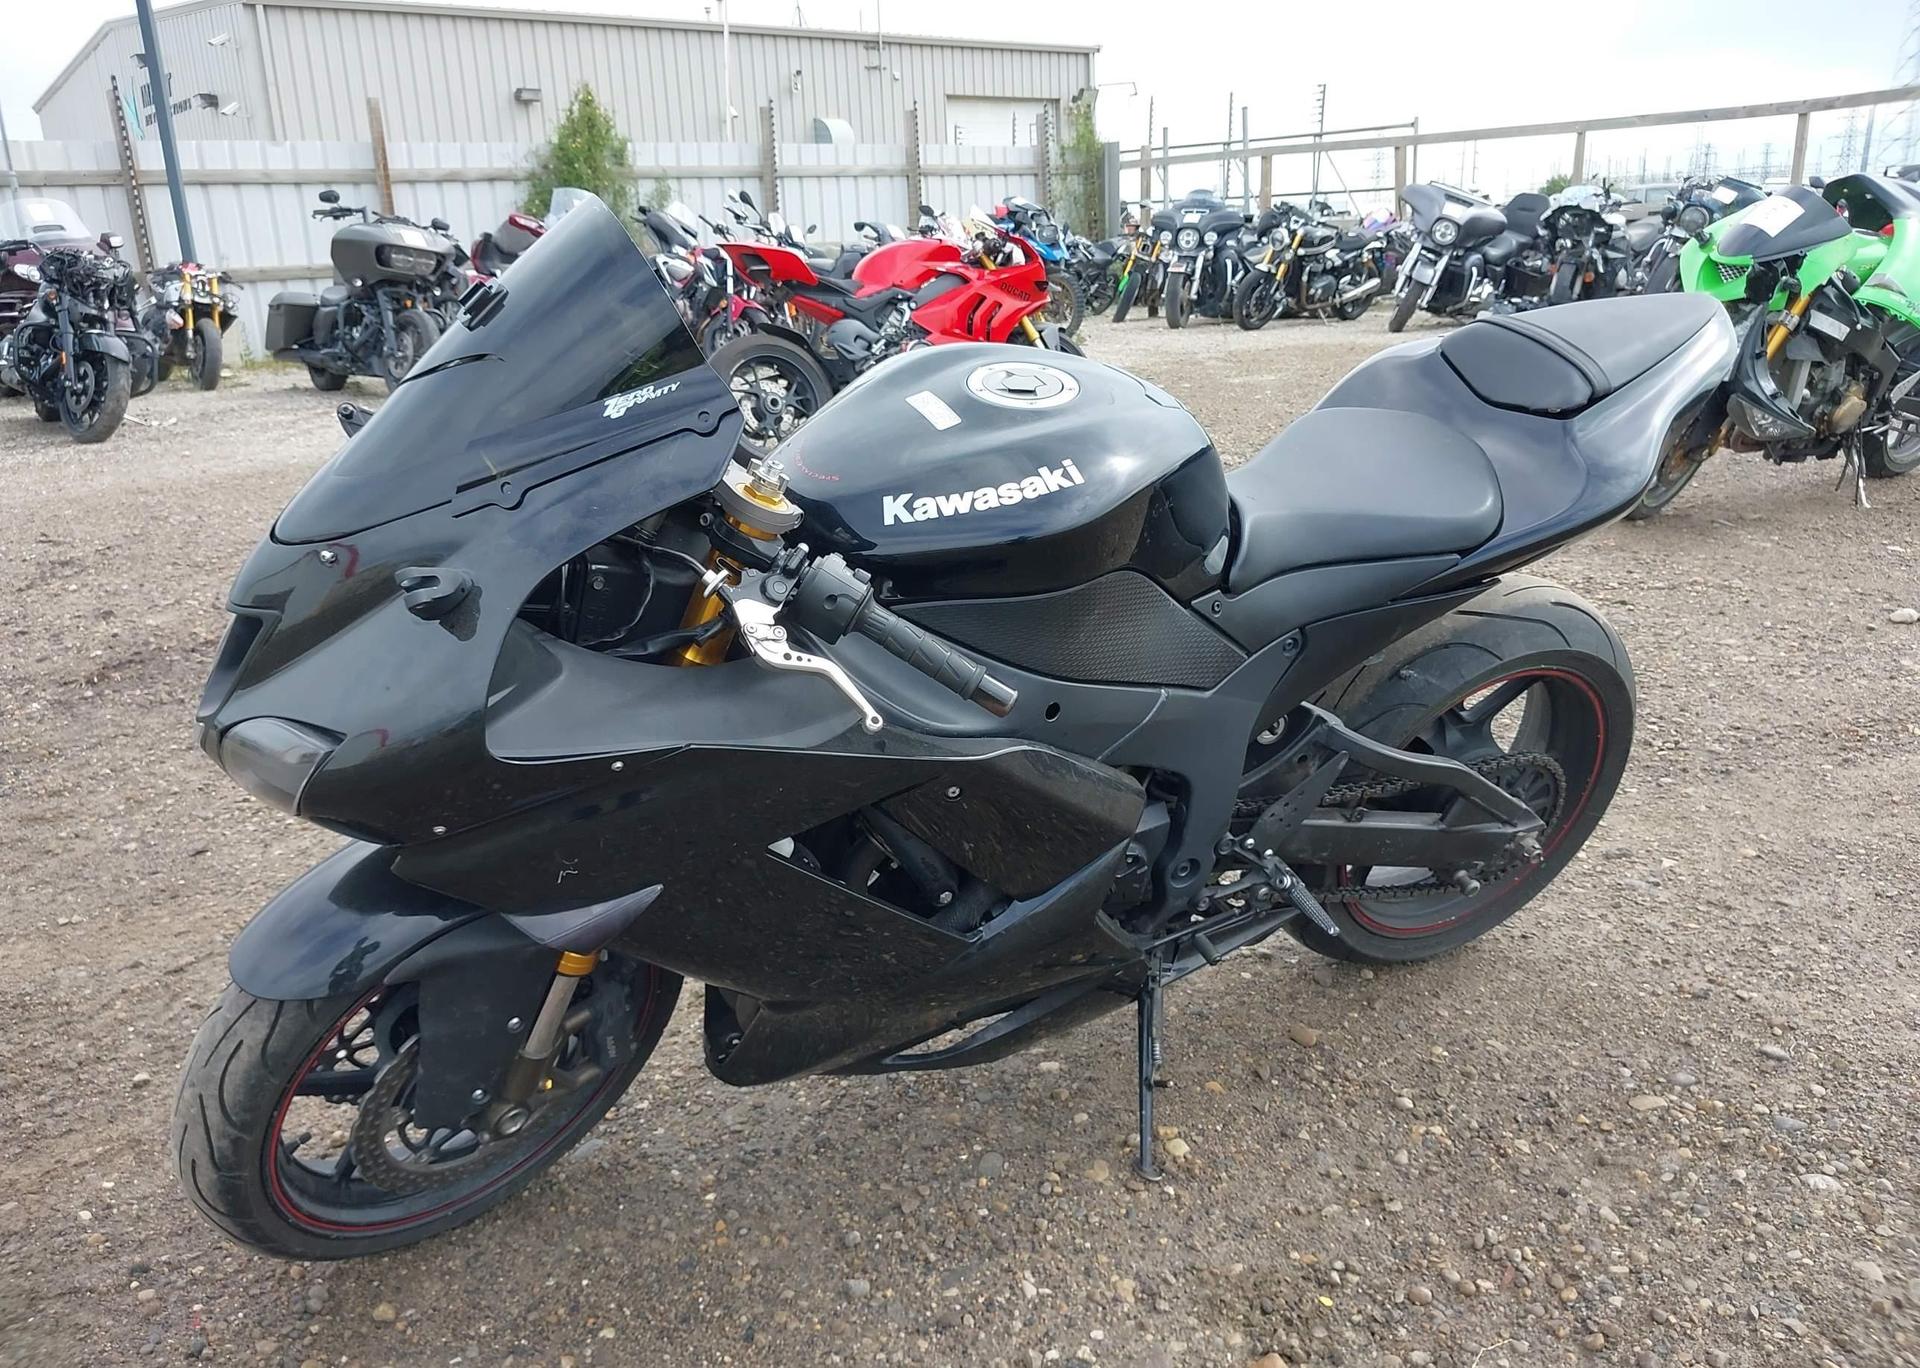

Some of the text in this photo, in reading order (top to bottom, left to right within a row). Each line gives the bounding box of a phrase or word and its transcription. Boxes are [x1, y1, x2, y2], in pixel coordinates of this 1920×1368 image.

[1001, 281, 1031, 301] DUCATI
[603, 385, 655, 417] ZERO
[610, 381, 680, 419] GRAVITY
[882, 459, 1085, 526] Kawasaki
